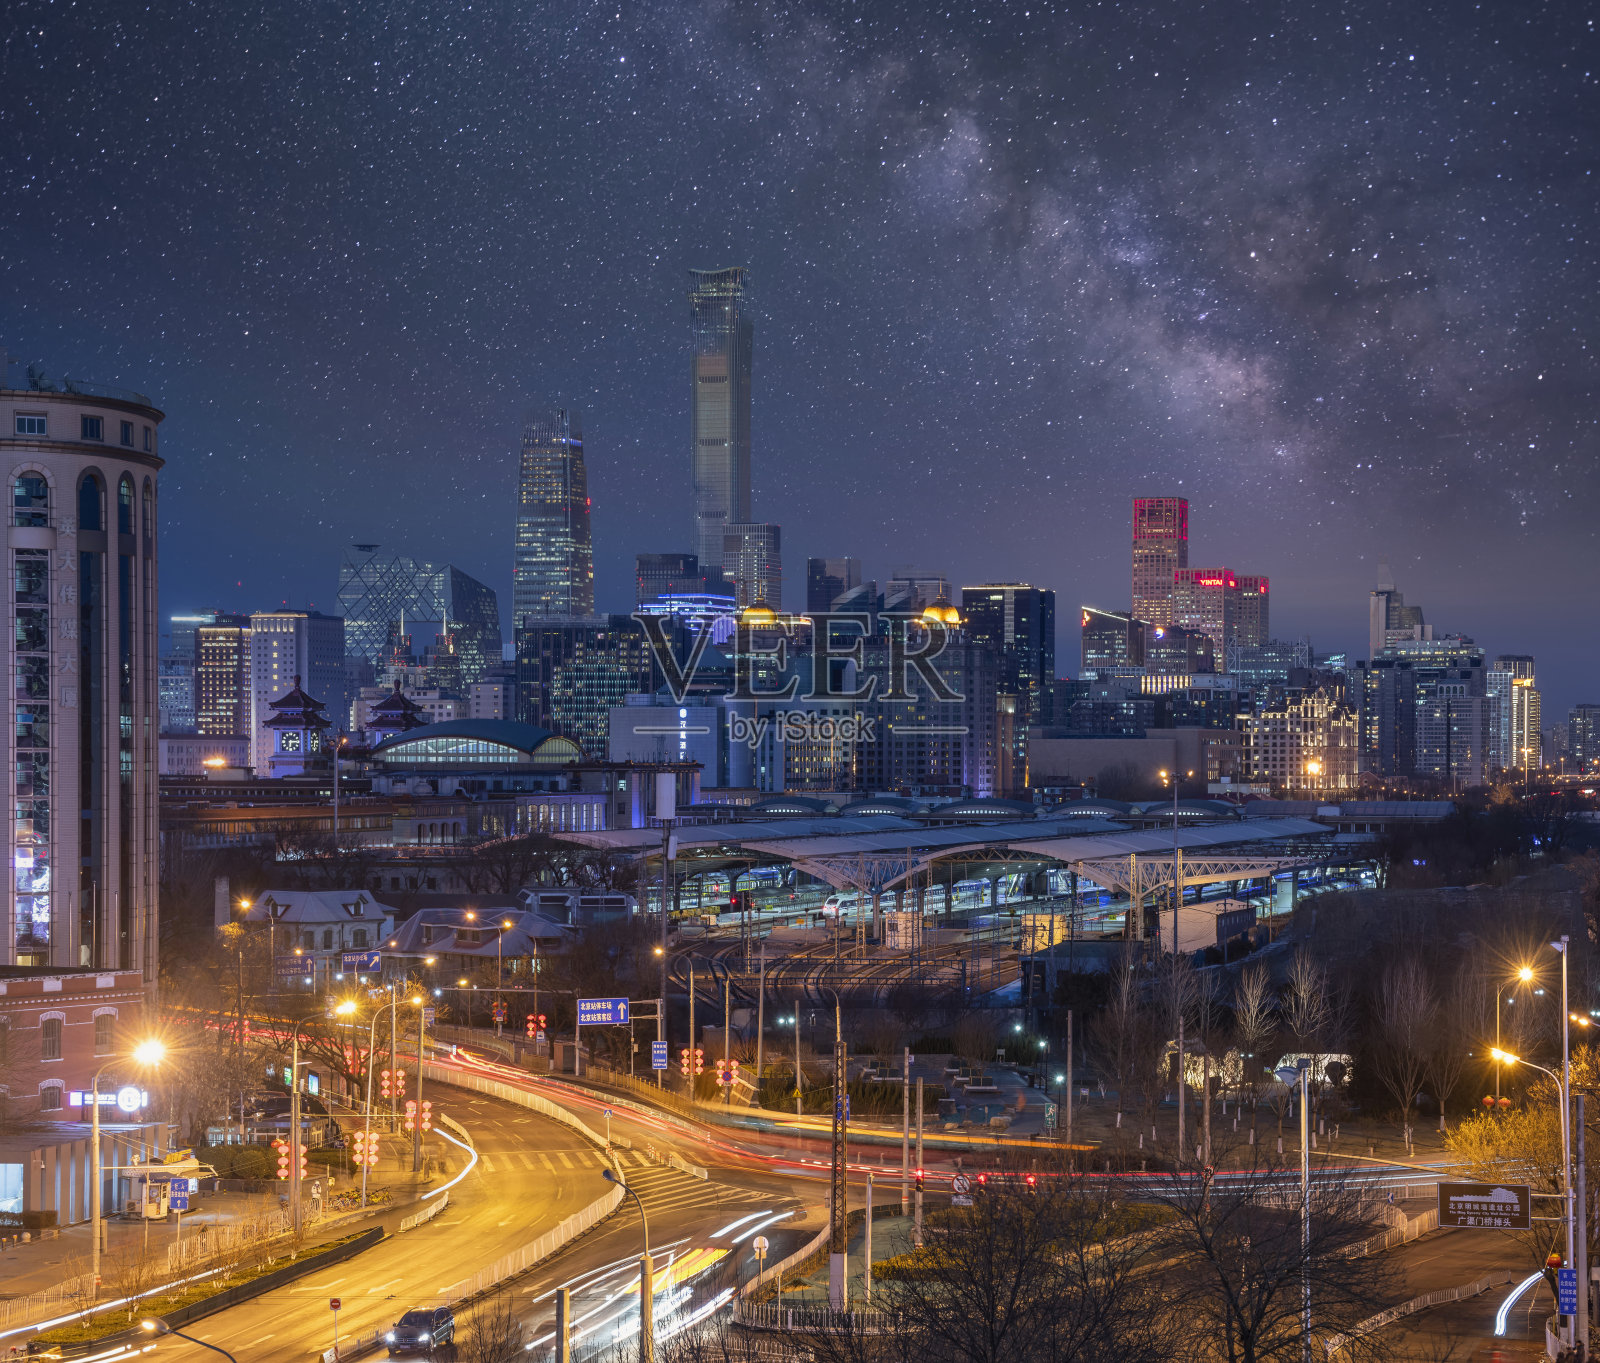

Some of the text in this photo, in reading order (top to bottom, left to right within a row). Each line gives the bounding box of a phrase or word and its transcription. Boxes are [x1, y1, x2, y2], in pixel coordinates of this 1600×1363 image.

[580, 1001, 612, 1010] 北京站停车场
[1449, 1202, 1520, 1212] 北京明城墙遗址公园
[1457, 1216, 1512, 1227] 广渠门桥掉头
